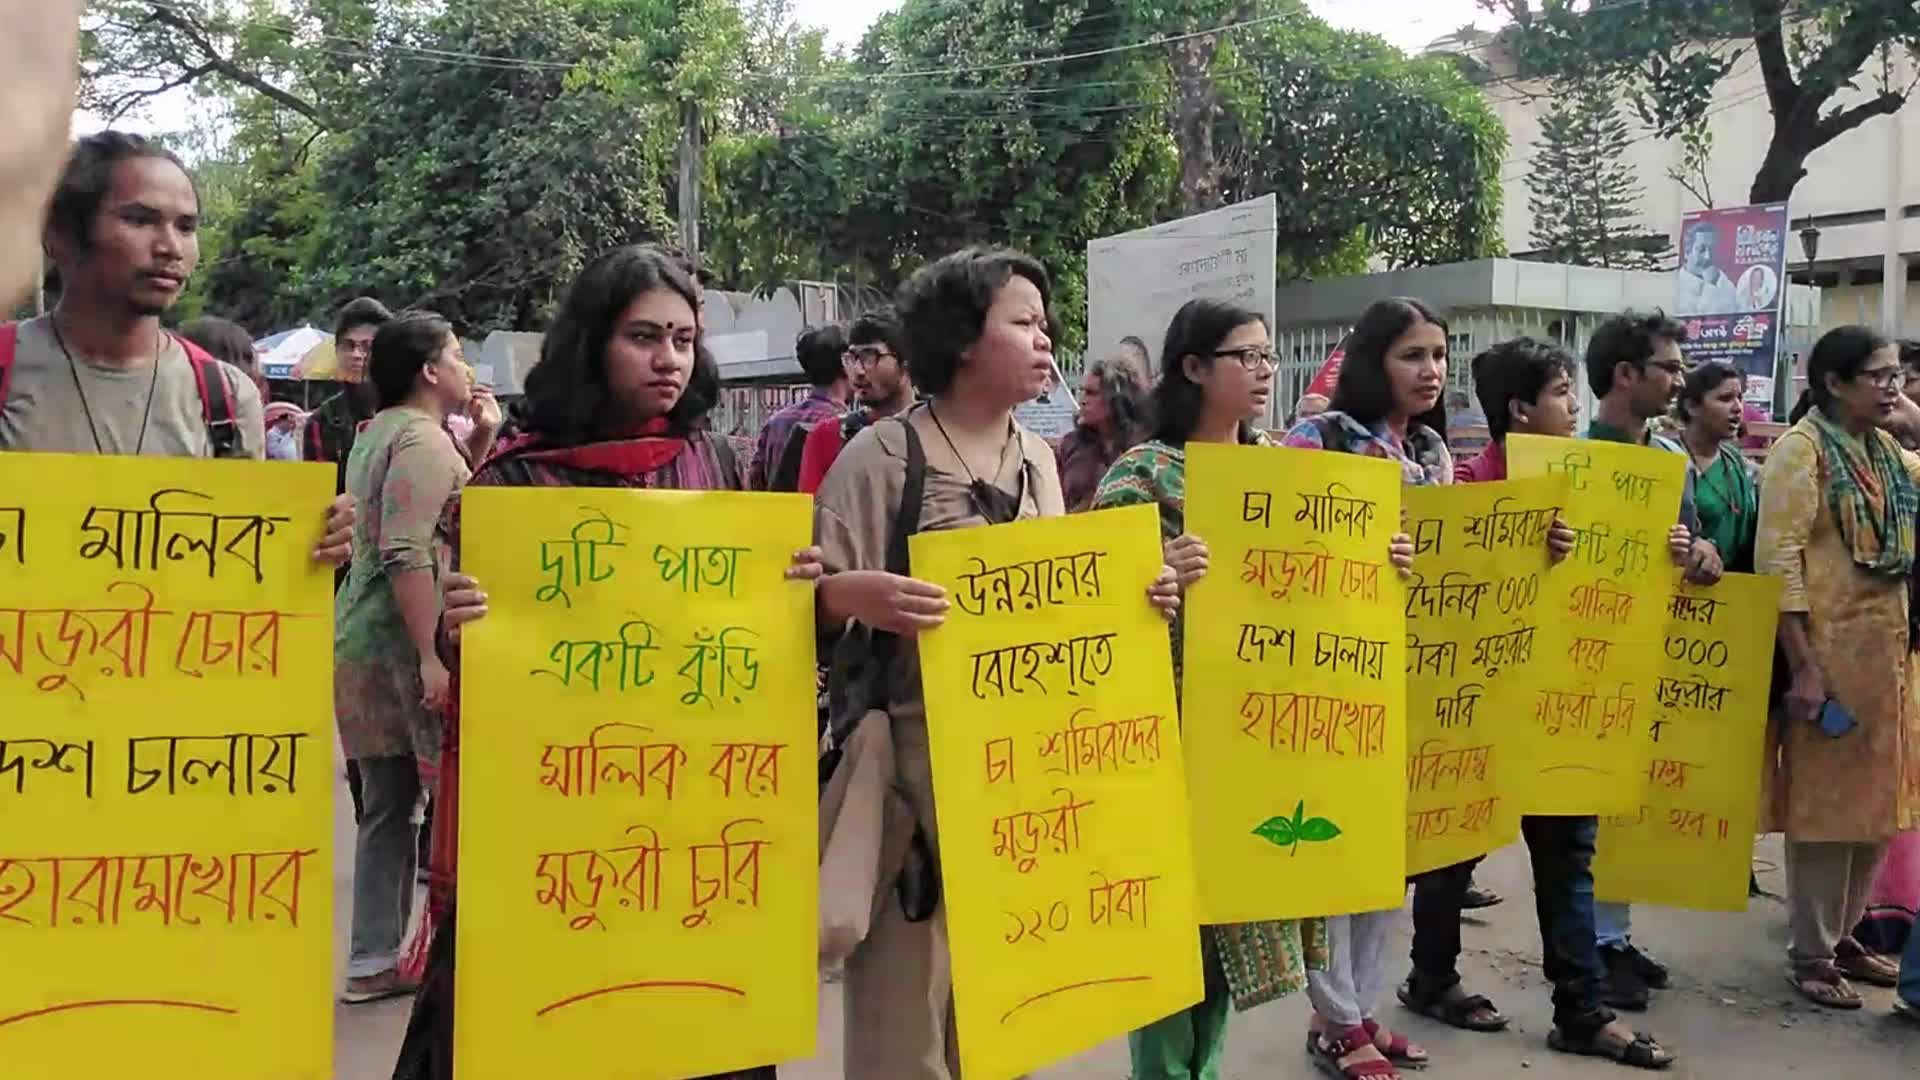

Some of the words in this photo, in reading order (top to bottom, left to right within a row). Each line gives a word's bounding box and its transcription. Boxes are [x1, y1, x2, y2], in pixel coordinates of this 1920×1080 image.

[80, 489, 291, 584] মালিক
[1242, 491, 1272, 529] চা
[1295, 482, 1376, 538] মালিক
[1414, 519, 1443, 555] চা
[1463, 497, 1562, 552] শ্রমিকদে
[536, 507, 630, 608] দুটি
[654, 545, 751, 598] পাতা
[1240, 541, 1335, 603] মজুরী
[1339, 558, 1384, 605] চোর
[1569, 522, 1611, 564] কটি
[955, 551, 1107, 616] উন্নয়নের
[1405, 572, 1491, 621] দৈনিক
[1497, 573, 1538, 614] ৩০০
[1568, 578, 1637, 625] মালিক
[176, 611, 324, 678] চোর
[531, 614, 661, 693] একটি
[679, 626, 761, 708] কুঁড়ি
[1237, 624, 1295, 666] দেশ
[1314, 632, 1389, 680] চালায়
[1472, 618, 1537, 678] মজুরীর
[1567, 637, 1616, 675] করে
[1665, 636, 1728, 668] ৩০০
[1239, 691, 1386, 757] হারামখোর
[1436, 684, 1485, 728] দাবি
[1597, 682, 1637, 740] চুরি
[128, 733, 309, 796] চালায়
[540, 723, 687, 801] মালিক
[709, 743, 789, 798] করে
[986, 736, 1015, 784] চা
[1039, 708, 1166, 777] শ্রমিকদের
[992, 787, 1094, 873] মজুরী
[0, 848, 318, 928] হারামখোর
[536, 825, 669, 931] মজুরী
[682, 819, 772, 928] চুরি
[1003, 901, 1069, 944] ১২০
[1089, 870, 1160, 928] টাকা
